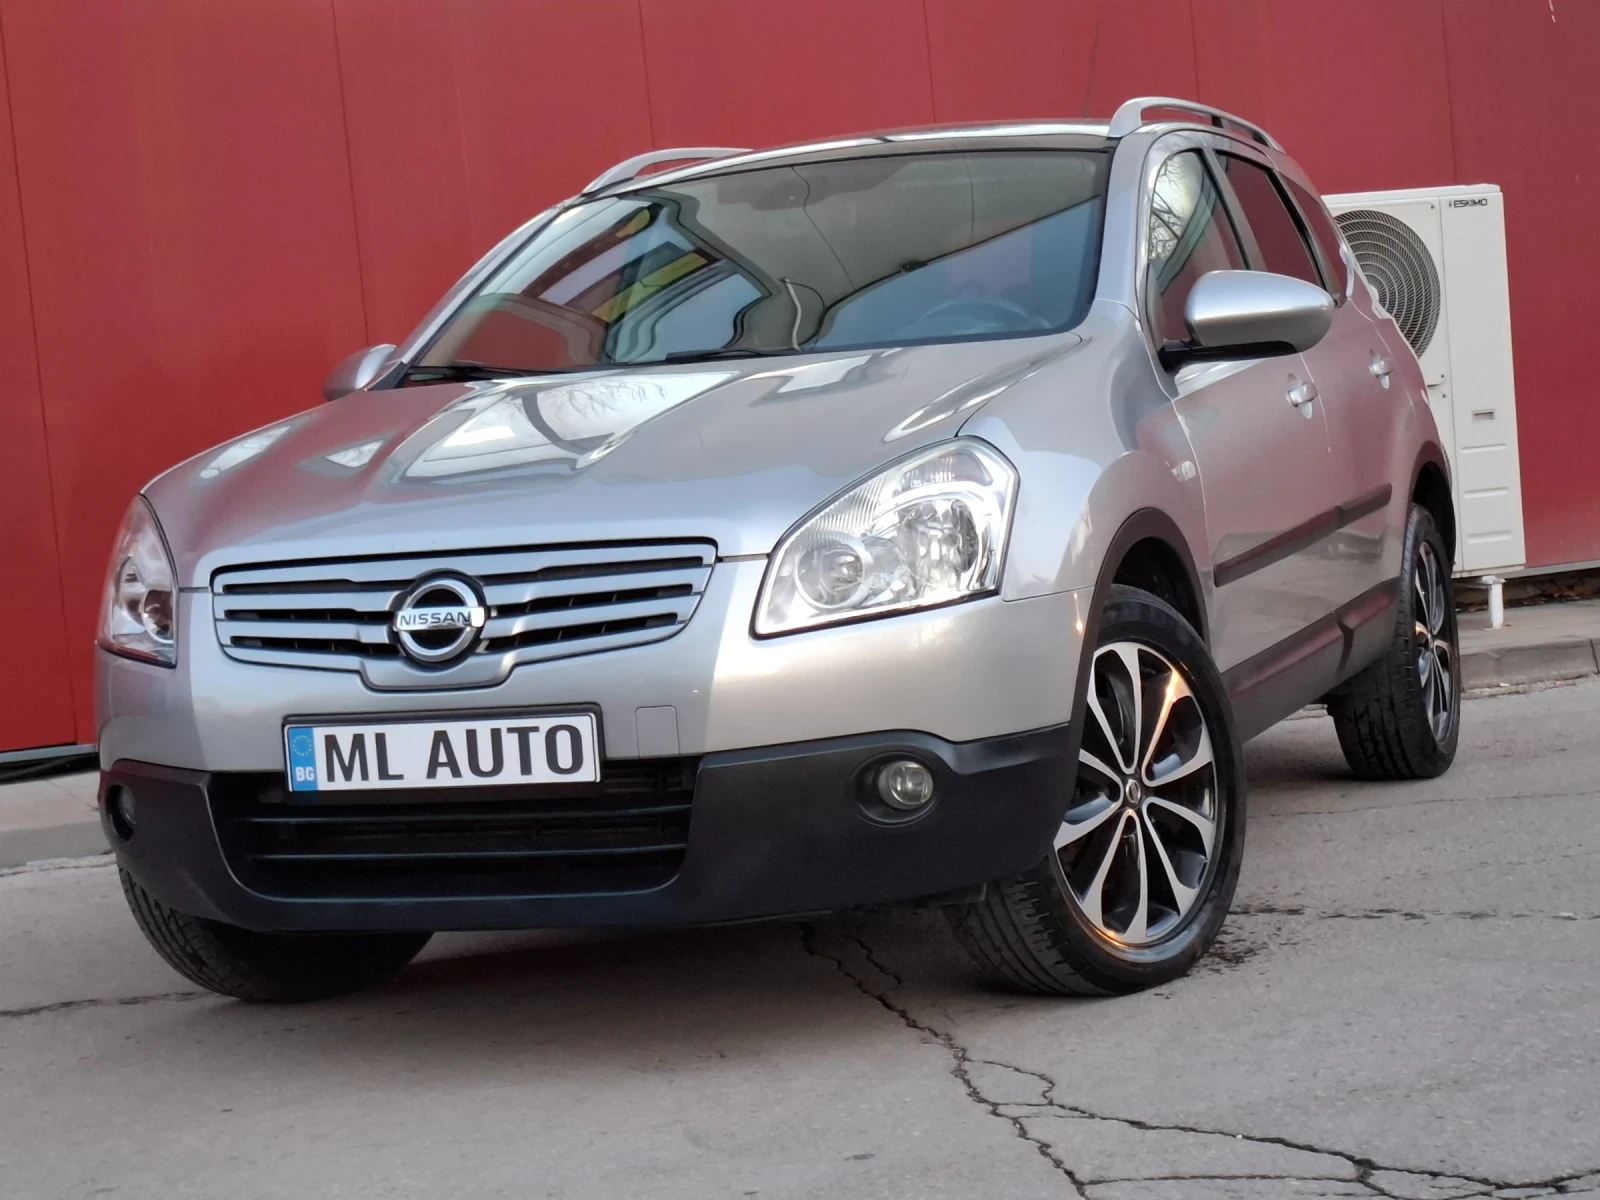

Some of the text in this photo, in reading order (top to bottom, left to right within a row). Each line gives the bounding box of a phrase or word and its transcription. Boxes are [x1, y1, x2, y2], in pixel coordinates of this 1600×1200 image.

[1453, 198, 1488, 208] ESKIMO
[400, 610, 472, 627] NISSAN
[324, 724, 584, 783] ML AUTO
[295, 766, 315, 782] BG
